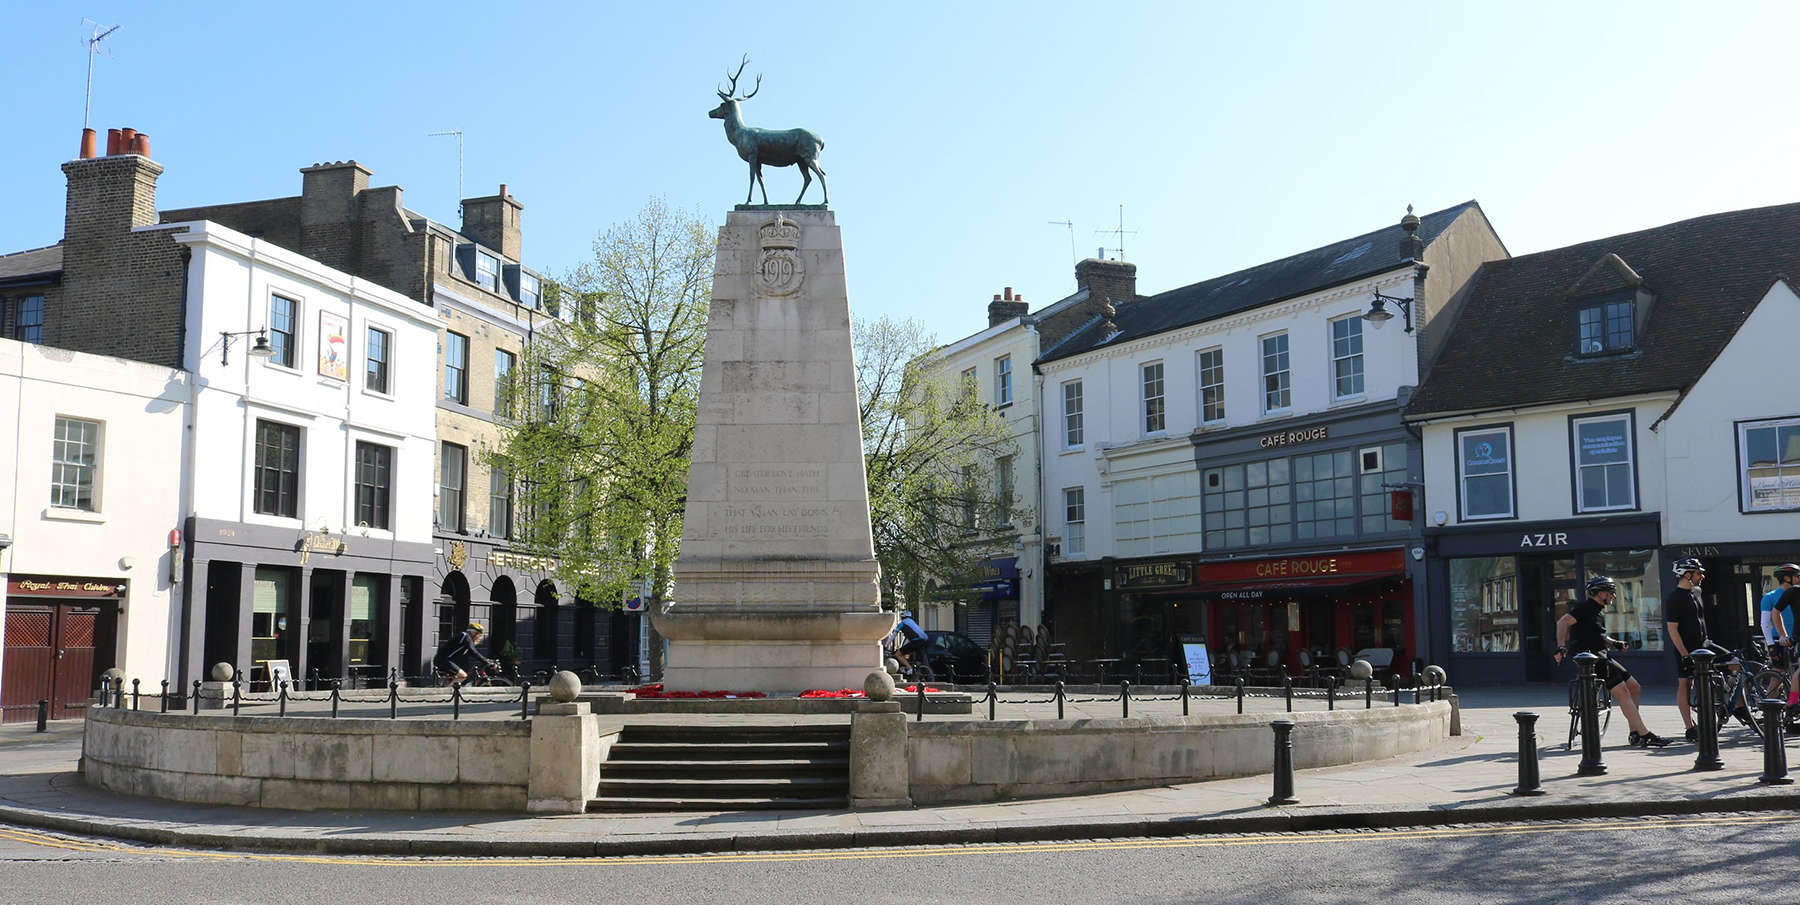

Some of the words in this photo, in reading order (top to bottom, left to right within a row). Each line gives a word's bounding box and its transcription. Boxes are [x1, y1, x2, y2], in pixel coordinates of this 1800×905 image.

[763, 259, 793, 287] 1919
[1260, 432, 1286, 448] CAFÉ
[1289, 427, 1327, 444] ROUGE
[735, 470, 770, 478] GREATER
[772, 470, 793, 478] LOVE
[797, 470, 820, 478] HATH
[734, 486, 748, 494] NO
[751, 486, 770, 494] MAN
[774, 486, 798, 494] THAN
[801, 486, 819, 494] THIS
[725, 508, 746, 517] THAT
[758, 508, 778, 517] MAN
[783, 508, 798, 517] LAY
[801, 508, 829, 517] DOWN
[725, 525, 739, 533] HIS
[741, 525, 757, 533] LIFE
[760, 525, 776, 533] FOR
[778, 525, 792, 533] HIS
[794, 525, 829, 533] FRIENDS
[1520, 532, 1569, 547] AZIR
[1681, 546, 1721, 557] SEVEN
[486, 551, 556, 571] HERTFORD
[1129, 566, 1153, 579] LITTLE
[1256, 560, 1288, 576] CAFÉ
[1291, 559, 1338, 574] ROUGE
[20, 580, 50, 591] Royal
[56, 582, 79, 590] Thai
[1221, 591, 1238, 599] OPEN
